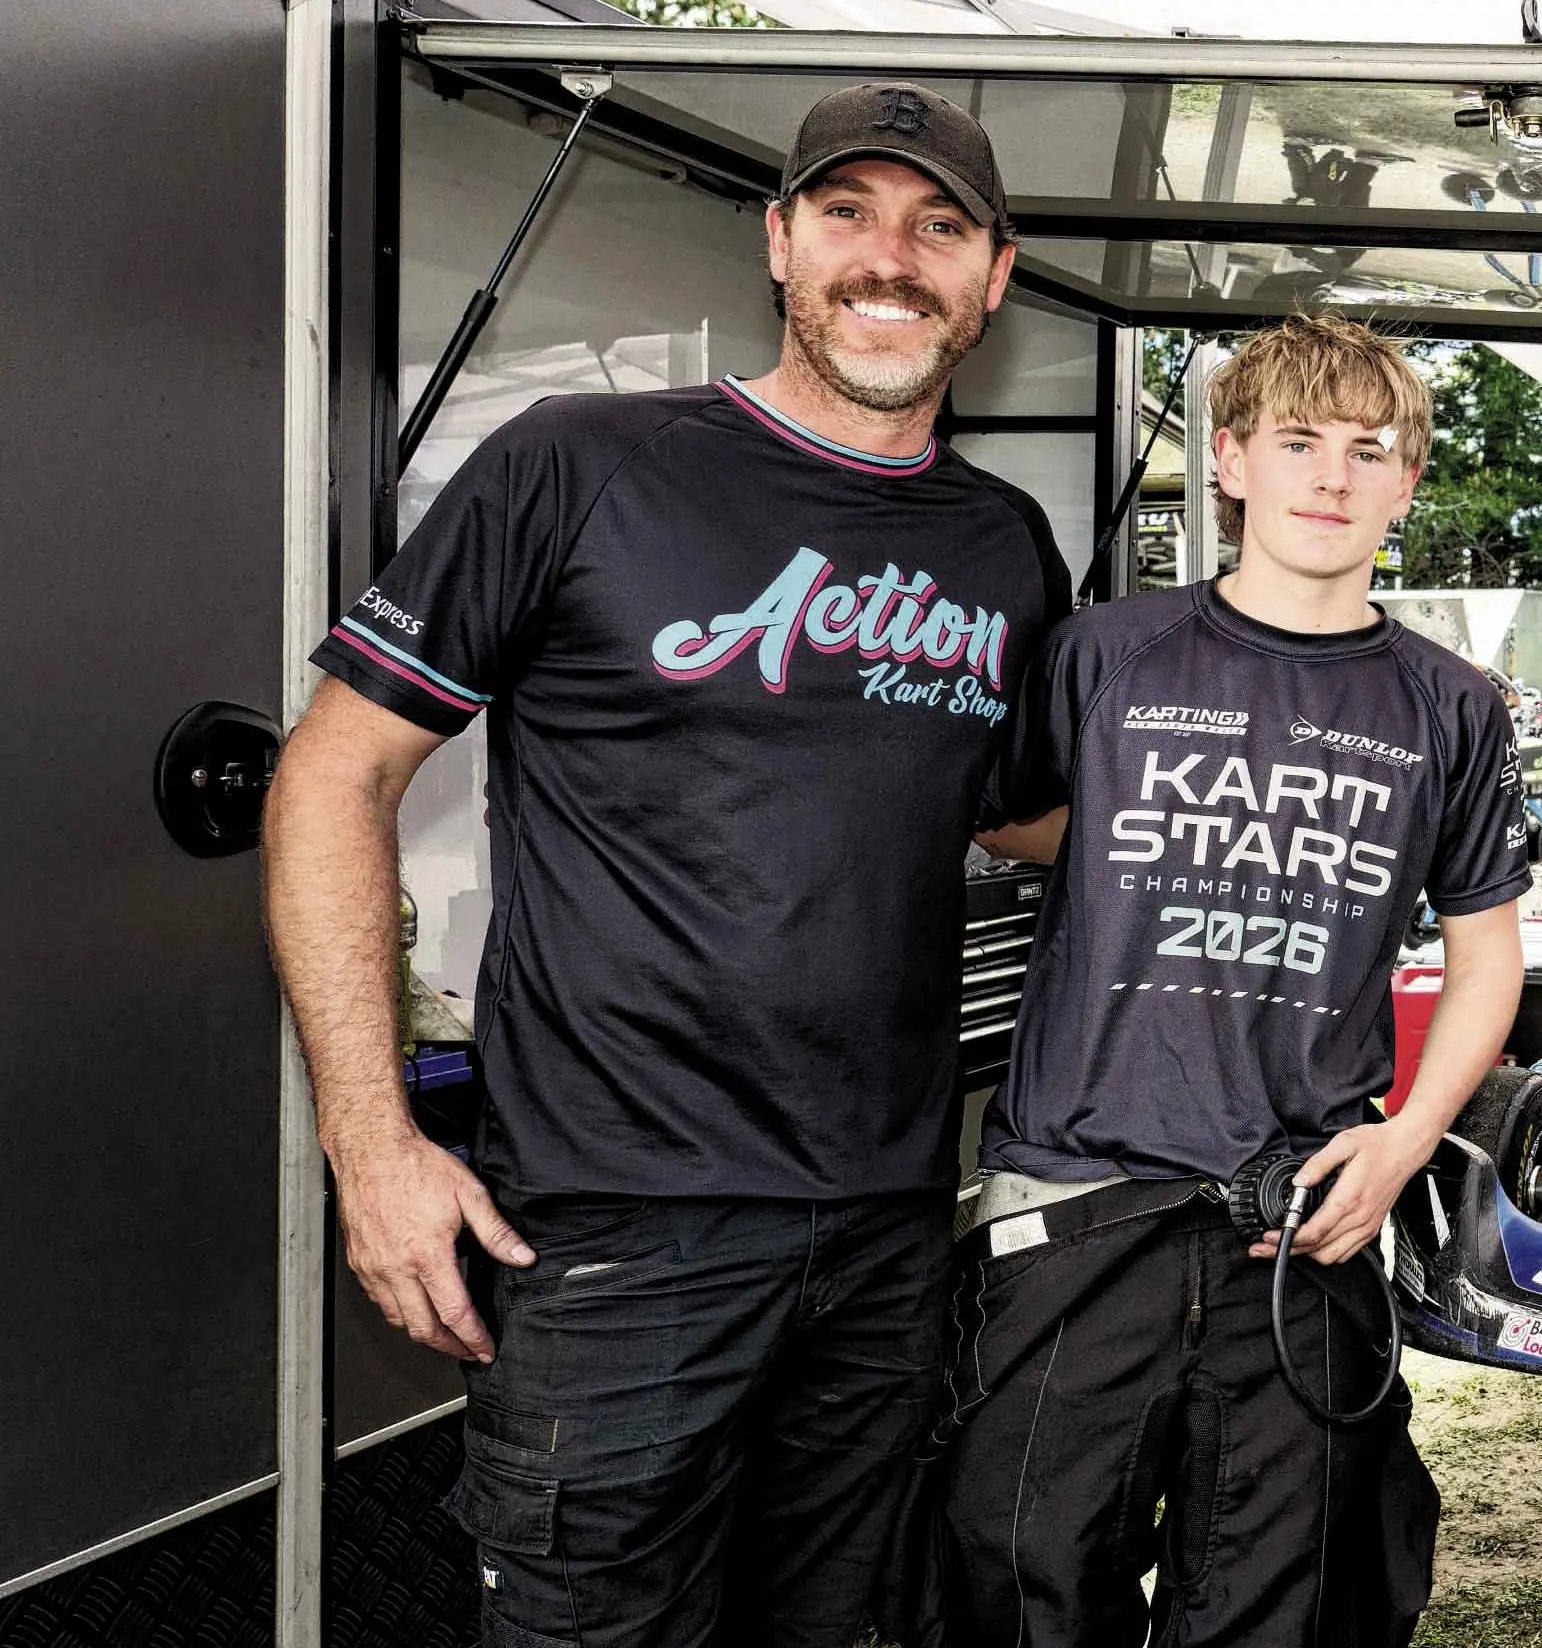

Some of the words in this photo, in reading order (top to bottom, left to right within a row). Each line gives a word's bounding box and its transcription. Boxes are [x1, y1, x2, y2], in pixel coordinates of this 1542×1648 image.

[359, 585, 425, 635] Express
[652, 546, 1008, 694] Action
[858, 661, 951, 707] Kart
[948, 675, 1008, 728] Shop
[1126, 706, 1236, 726] KARTING
[1322, 729, 1424, 763] DUNLOP
[1140, 751, 1392, 828] KART
[1108, 809, 1398, 896] STARS
[1119, 874, 1365, 919] CHAMPIONSHIP
[1156, 906, 1330, 975] 2026
